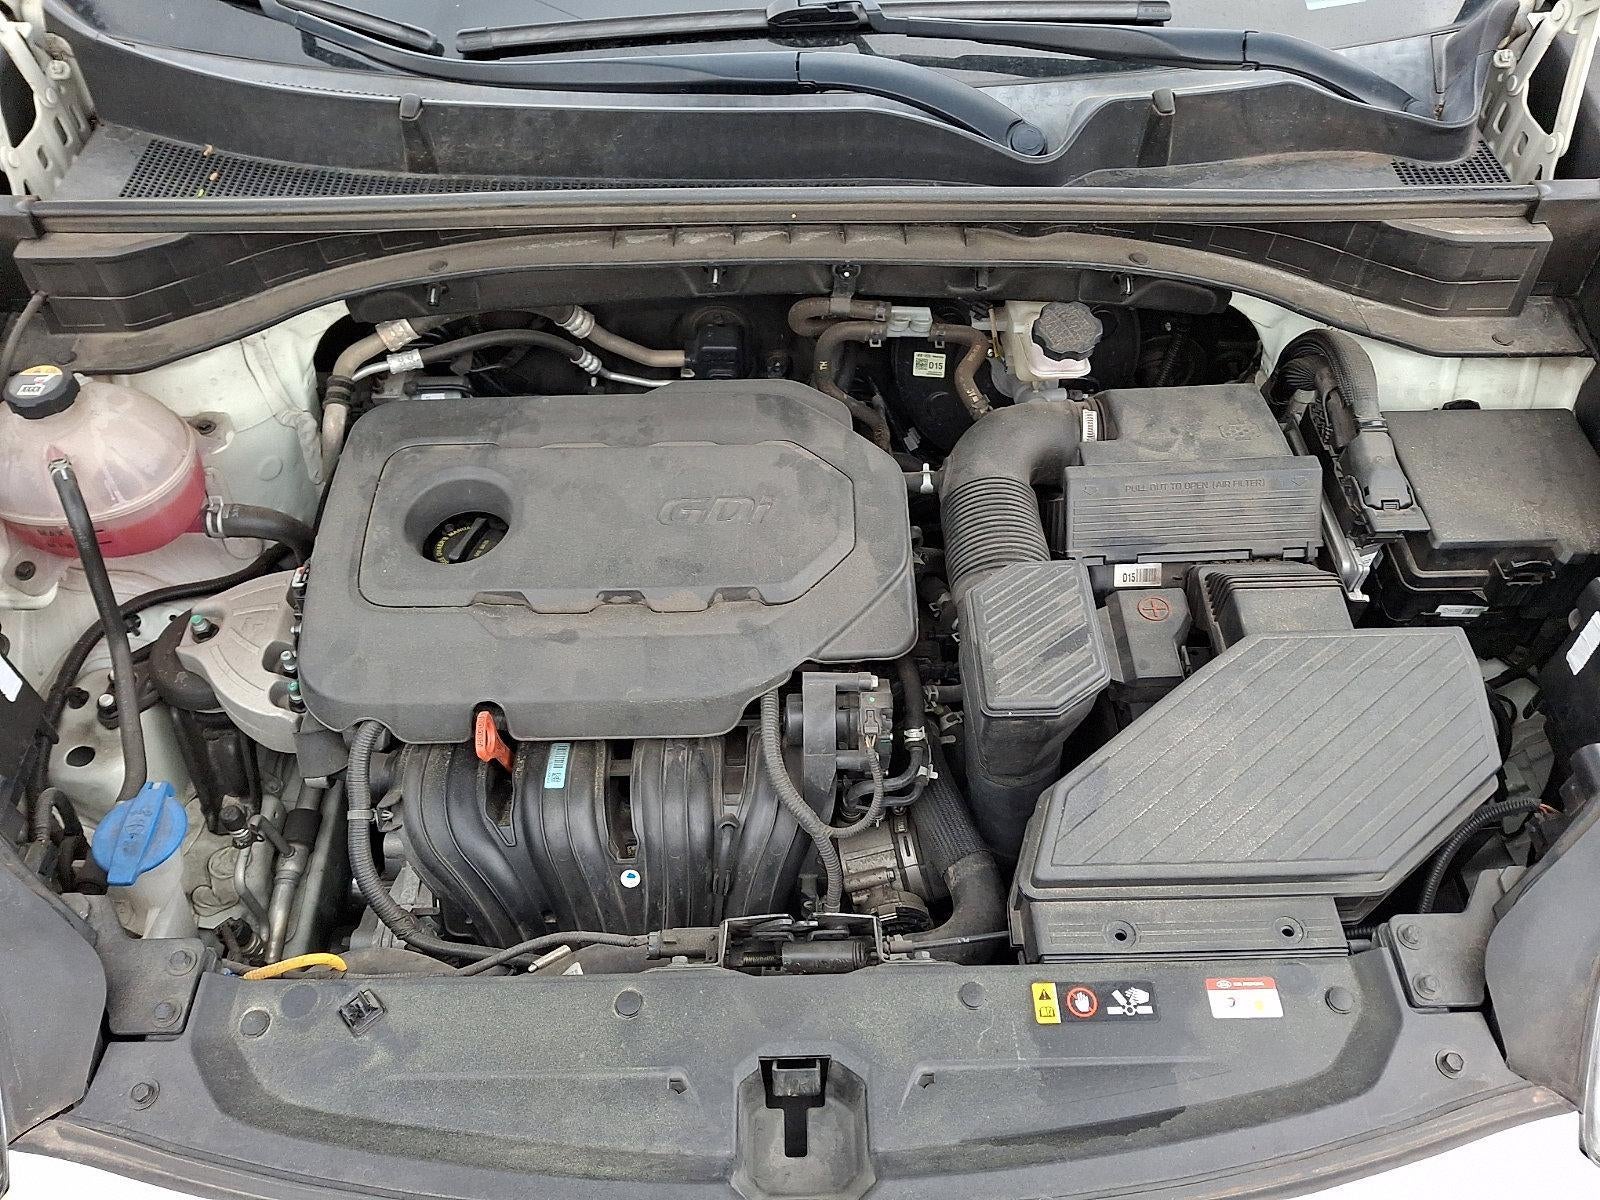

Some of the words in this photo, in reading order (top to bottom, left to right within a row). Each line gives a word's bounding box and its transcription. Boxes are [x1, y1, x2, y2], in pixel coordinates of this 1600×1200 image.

[1125, 483, 1147, 492] PULL
[1149, 482, 1167, 491] OUT
[1170, 481, 1182, 490] TO
[1184, 480, 1209, 489] OPEN
